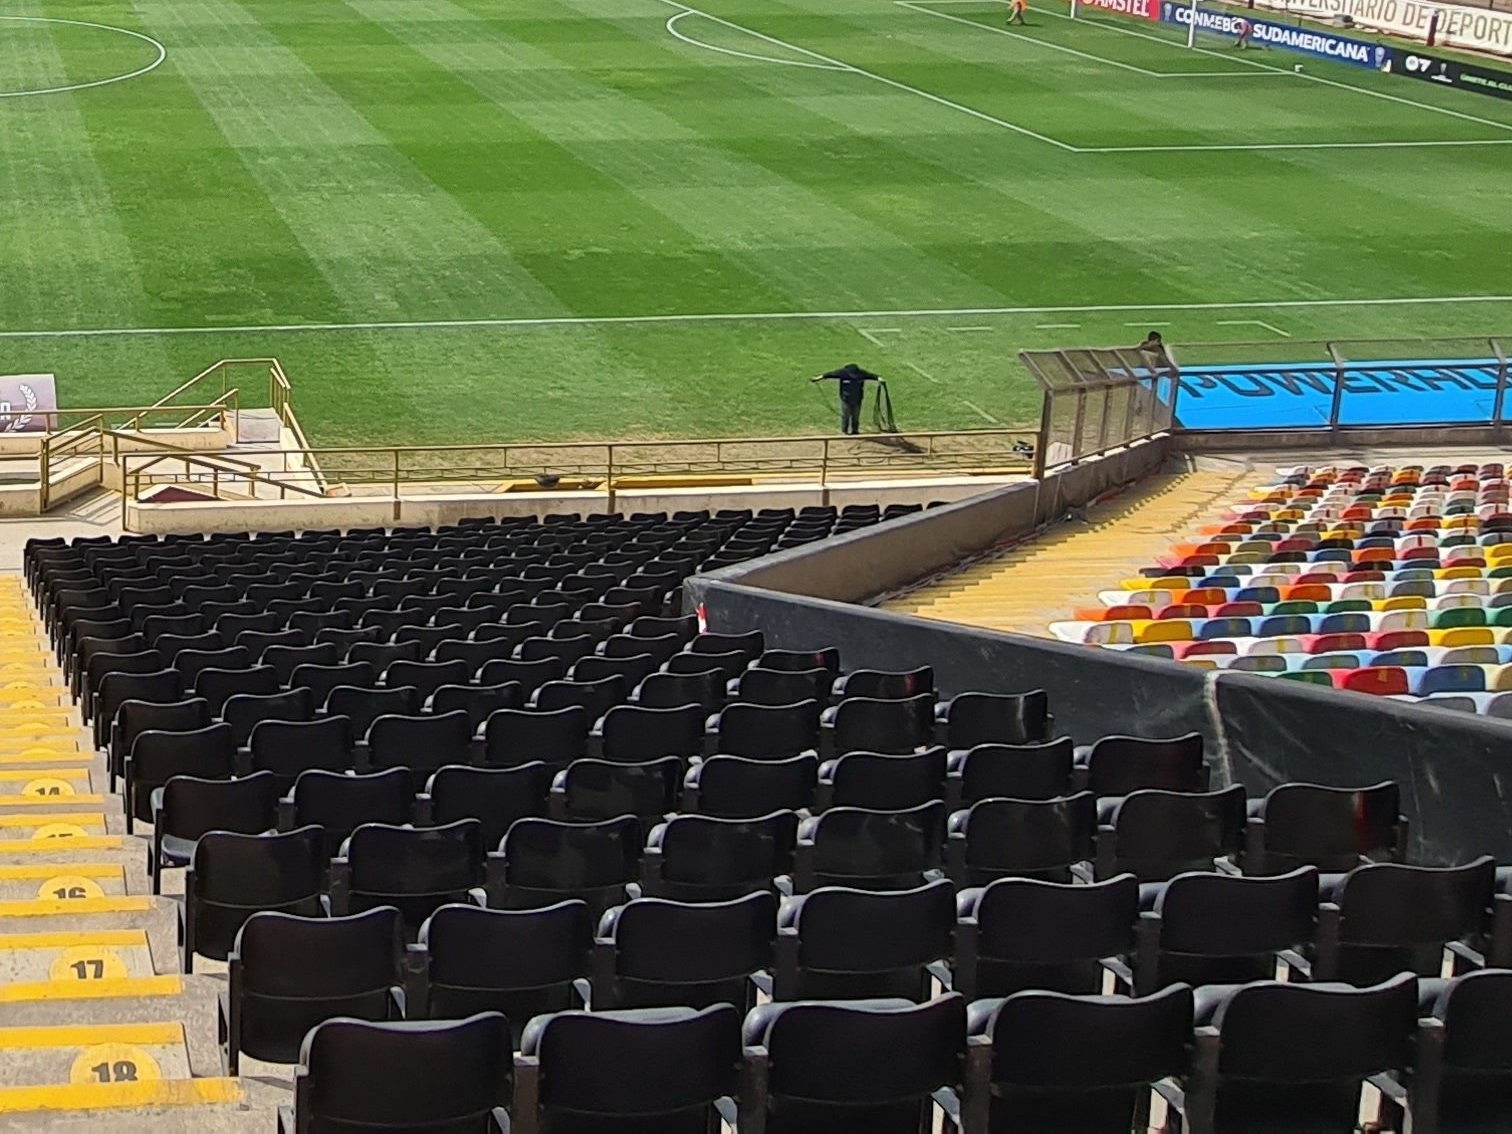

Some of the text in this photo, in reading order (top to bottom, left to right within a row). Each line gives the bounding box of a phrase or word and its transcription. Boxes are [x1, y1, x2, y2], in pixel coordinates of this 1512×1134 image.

[1402, 2, 1430, 30] DE
[1252, 24, 1369, 63] SUDAMERICANA
[53, 887, 89, 901] 16
[69, 959, 104, 980] 17
[91, 1061, 139, 1081] 18
